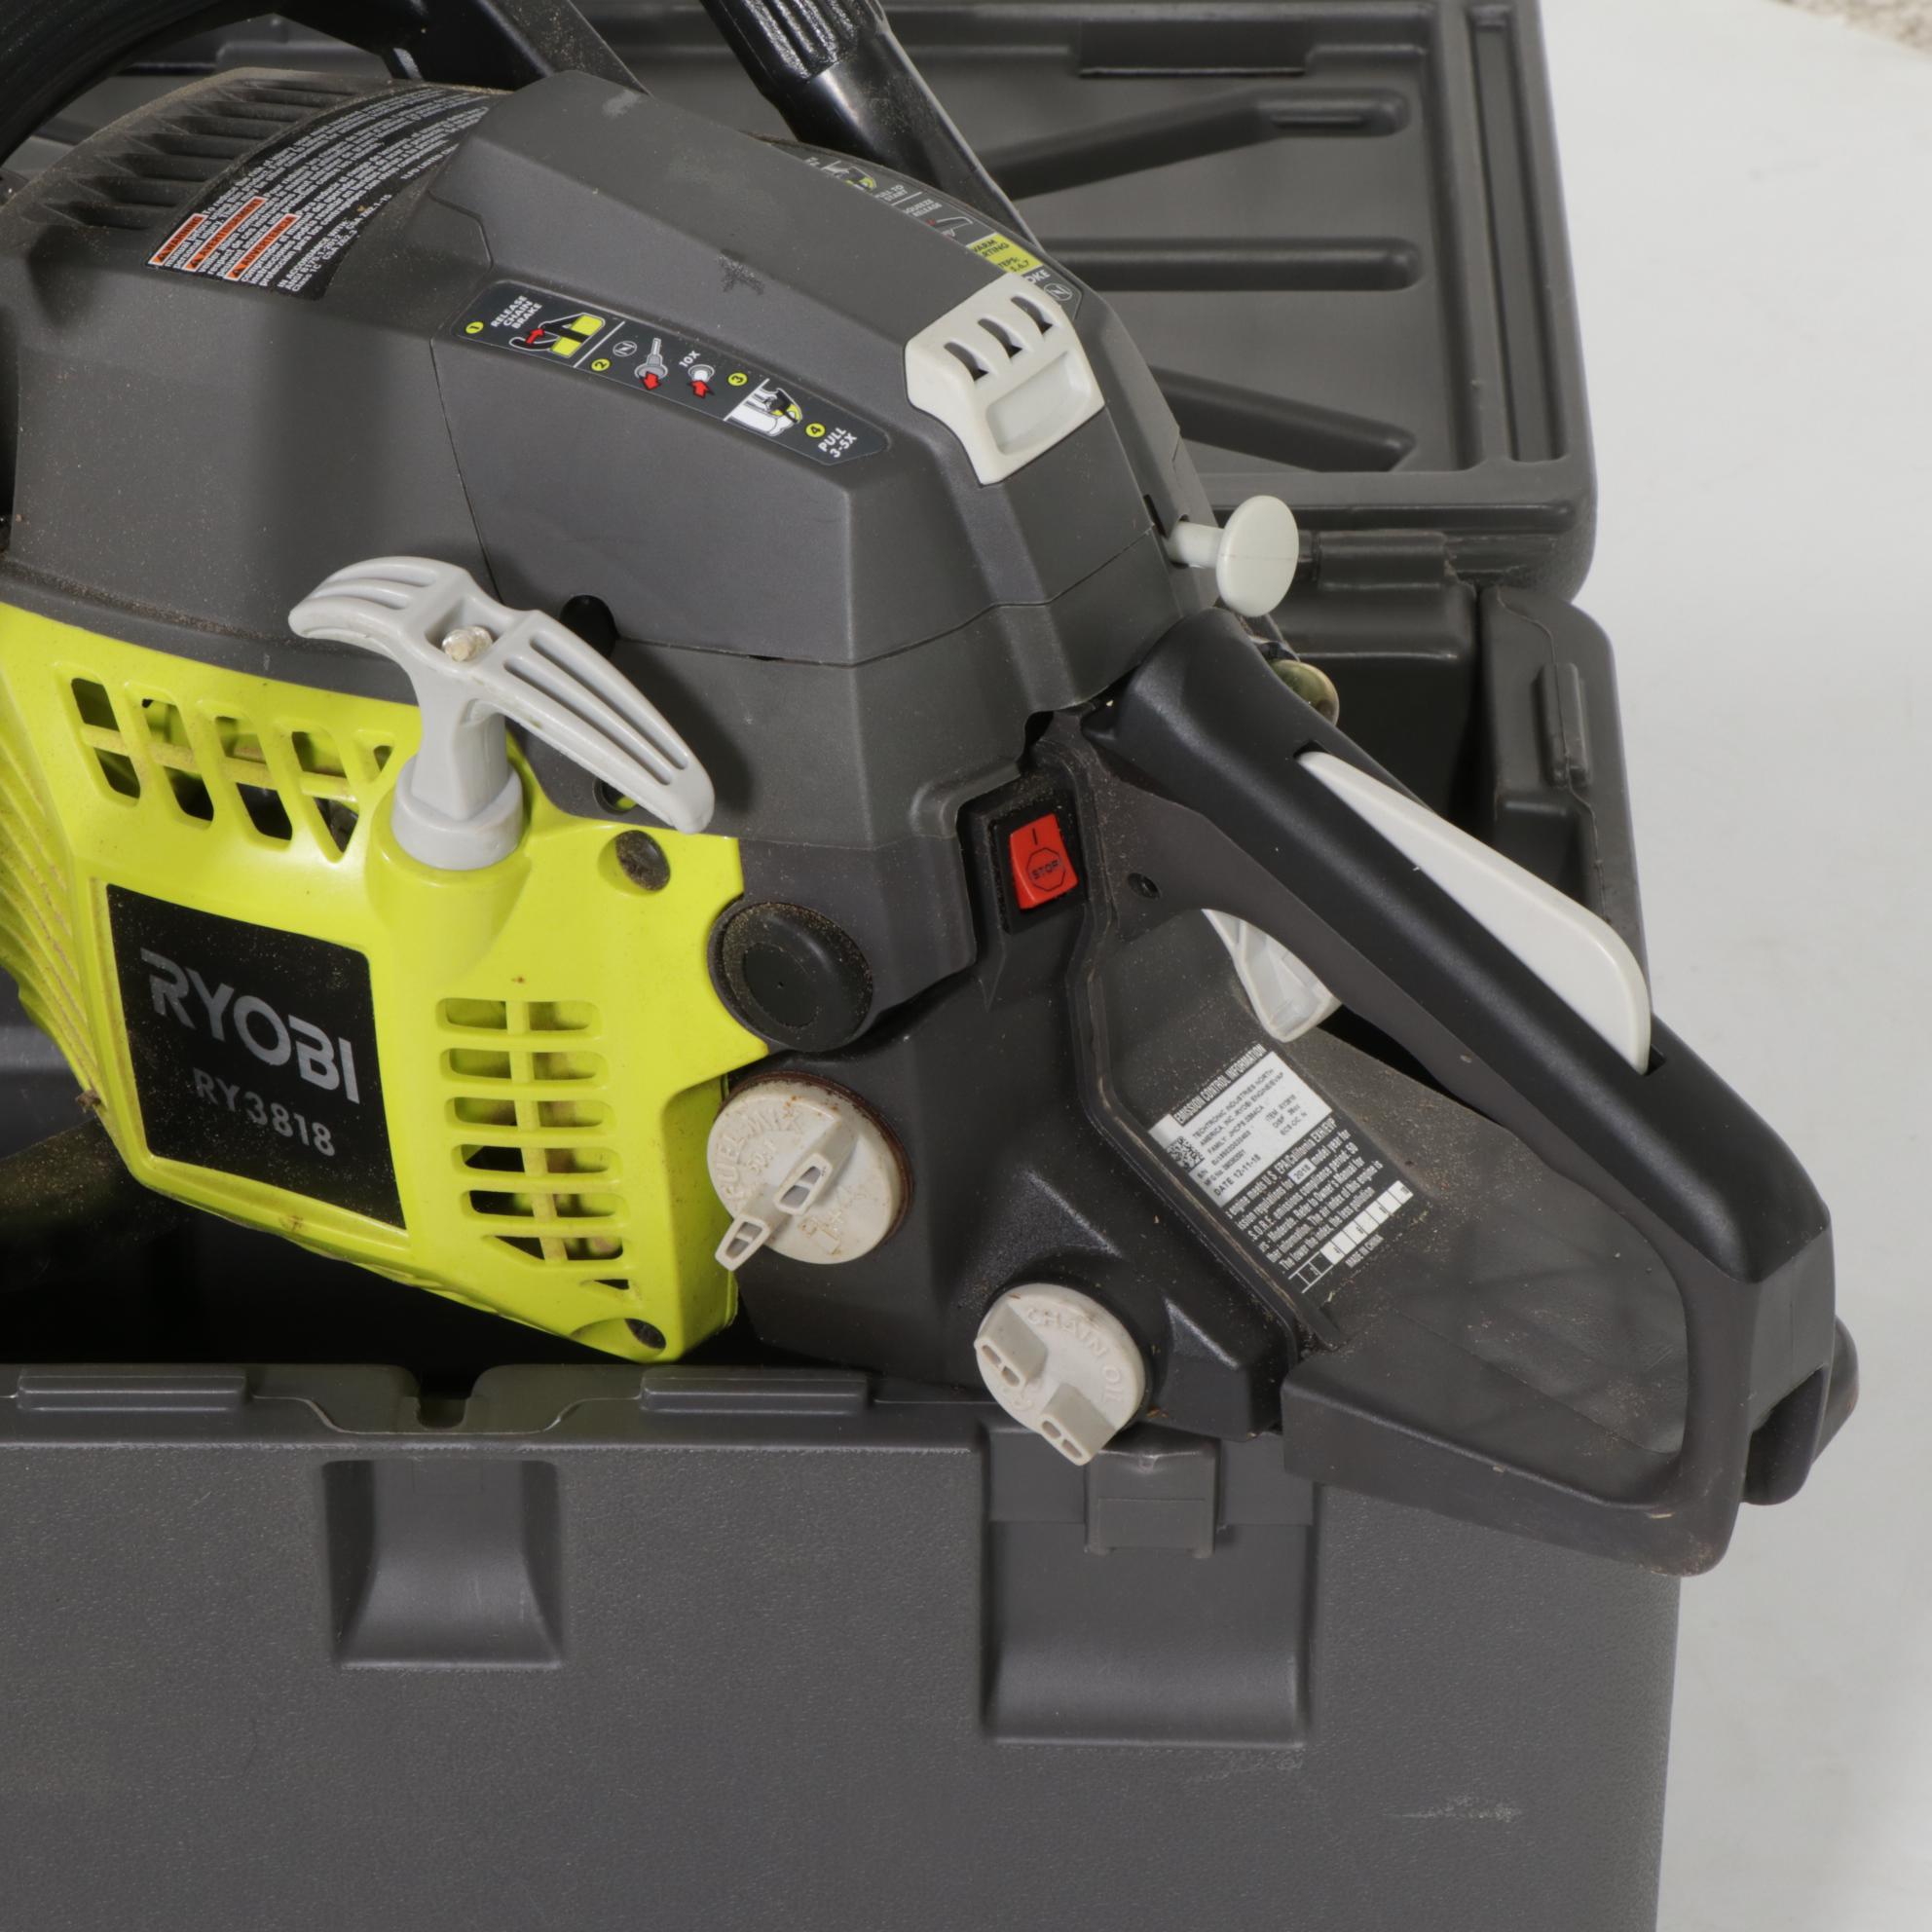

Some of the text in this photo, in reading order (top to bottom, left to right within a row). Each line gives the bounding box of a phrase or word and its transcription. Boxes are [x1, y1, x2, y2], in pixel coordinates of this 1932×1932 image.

[160, 214, 205, 251] WARNING
[201, 205, 215, 214] To
[209, 186, 240, 206] reduce
[233, 176, 251, 186] the
[245, 166, 266, 176] risk
[309, 202, 328, 212] del
[320, 178, 361, 203] operador
[161, 241, 193, 266] manual
[184, 219, 214, 241] before
[206, 202, 234, 220] using
[225, 190, 246, 203] this
[240, 168, 276, 191] product.
[168, 239, 204, 268] personal
[196, 218, 226, 239] injury.
[217, 201, 244, 218] There
[238, 187, 262, 202] may
[262, 166, 288, 181] other
[197, 198, 266, 254] AVERTISSEMENT
[261, 183, 285, 198] Pour
[203, 248, 236, 275] respect
[228, 239, 245, 248] de
[238, 226, 258, 240] ces
[249, 192, 298, 227] instructions
[290, 179, 316, 194] peut
[212, 159, 355, 277] peuvent assurer une protection contre les
[235, 196, 282, 232] comprendre
[237, 214, 300, 265] ADVERTENCIA
[294, 201, 318, 215] Para
[311, 181, 343, 202] reducir
[343, 161, 375, 177] riesgo
[254, 249, 299, 285] protección
[290, 235, 315, 250] para
[306, 224, 324, 236] los
[361, 178, 383, 190] con
[375, 167, 401, 180] otros
[283, 211, 316, 235] manual
[245, 239, 298, 283] instrucciones
[312, 197, 347, 220] resultar
[340, 189, 356, 198] en
[276, 234, 291, 242] el
[237, 242, 284, 282] comprender
[275, 236, 333, 287] IN ACCORDANCE
[289, 273, 315, 291] Class
[307, 263, 322, 273] 1C
[282, 272, 305, 289] ANSI
[490, 295, 529, 328] RELEASE
[502, 300, 534, 327] CHAIN
[511, 303, 543, 329] BRAKE
[679, 350, 701, 368] 10X
[818, 427, 847, 453] PULL
[829, 432, 858, 459] 3-5X
[1032, 860, 1059, 880] STOP
[139, 947, 361, 1105] RYOBI
[1171, 1043, 1268, 1125] EMISSION CONTROL INFORMATION
[194, 1067, 336, 1158] RY3818
[1191, 1067, 1275, 1139] TECHTRONIC INDUSTRIES NORTH
[1212, 1176, 1234, 1196] DATE
[1231, 1152, 1261, 1179] 12-11-18
[1228, 1195, 1252, 1217] engine
[1245, 1180, 1268, 1200] meets
[1260, 1168, 1282, 1187] U.S.
[1273, 1136, 1317, 1174] EPA/California
[1309, 1116, 1339, 1143] EXH/EVP
[1234, 1209, 1257, 1231] ission
[1250, 1183, 1288, 1218] regulations
[1280, 1176, 1295, 1191] for
[1292, 1163, 1312, 1180] 2018
[1307, 1144, 1331, 1166] model
[1325, 1134, 1345, 1154] year
[1335, 1126, 1352, 1141] for
[1270, 1140, 1359, 1220] emissions compliance period: 50
[1354, 1163, 1379, 1186] engine
[1371, 1158, 1384, 1170] is
[1266, 1153, 1365, 1243] Moderate. Refer to Owner's Manual for
[1324, 1192, 1345, 1210] index
[1338, 1186, 1351, 1199] of
[1344, 1177, 1360, 1194] this
[1279, 1254, 1295, 1271] The
[1289, 1243, 1310, 1262] lower
[1304, 1235, 1319, 1249] the
[1327, 1213, 1343, 1228] the
[1336, 1203, 1355, 1220] less
[1347, 1183, 1377, 1212] pollution
[1307, 1210, 1323, 1226] The
[1317, 1204, 1331, 1217] air
[1276, 1219, 1314, 1254] information.
[1344, 1249, 1364, 1269] MADE
[1357, 1245, 1369, 1256] IN
[1363, 1232, 1384, 1251] CHINA
[1027, 1306, 1125, 1403] CHAIN OIL
